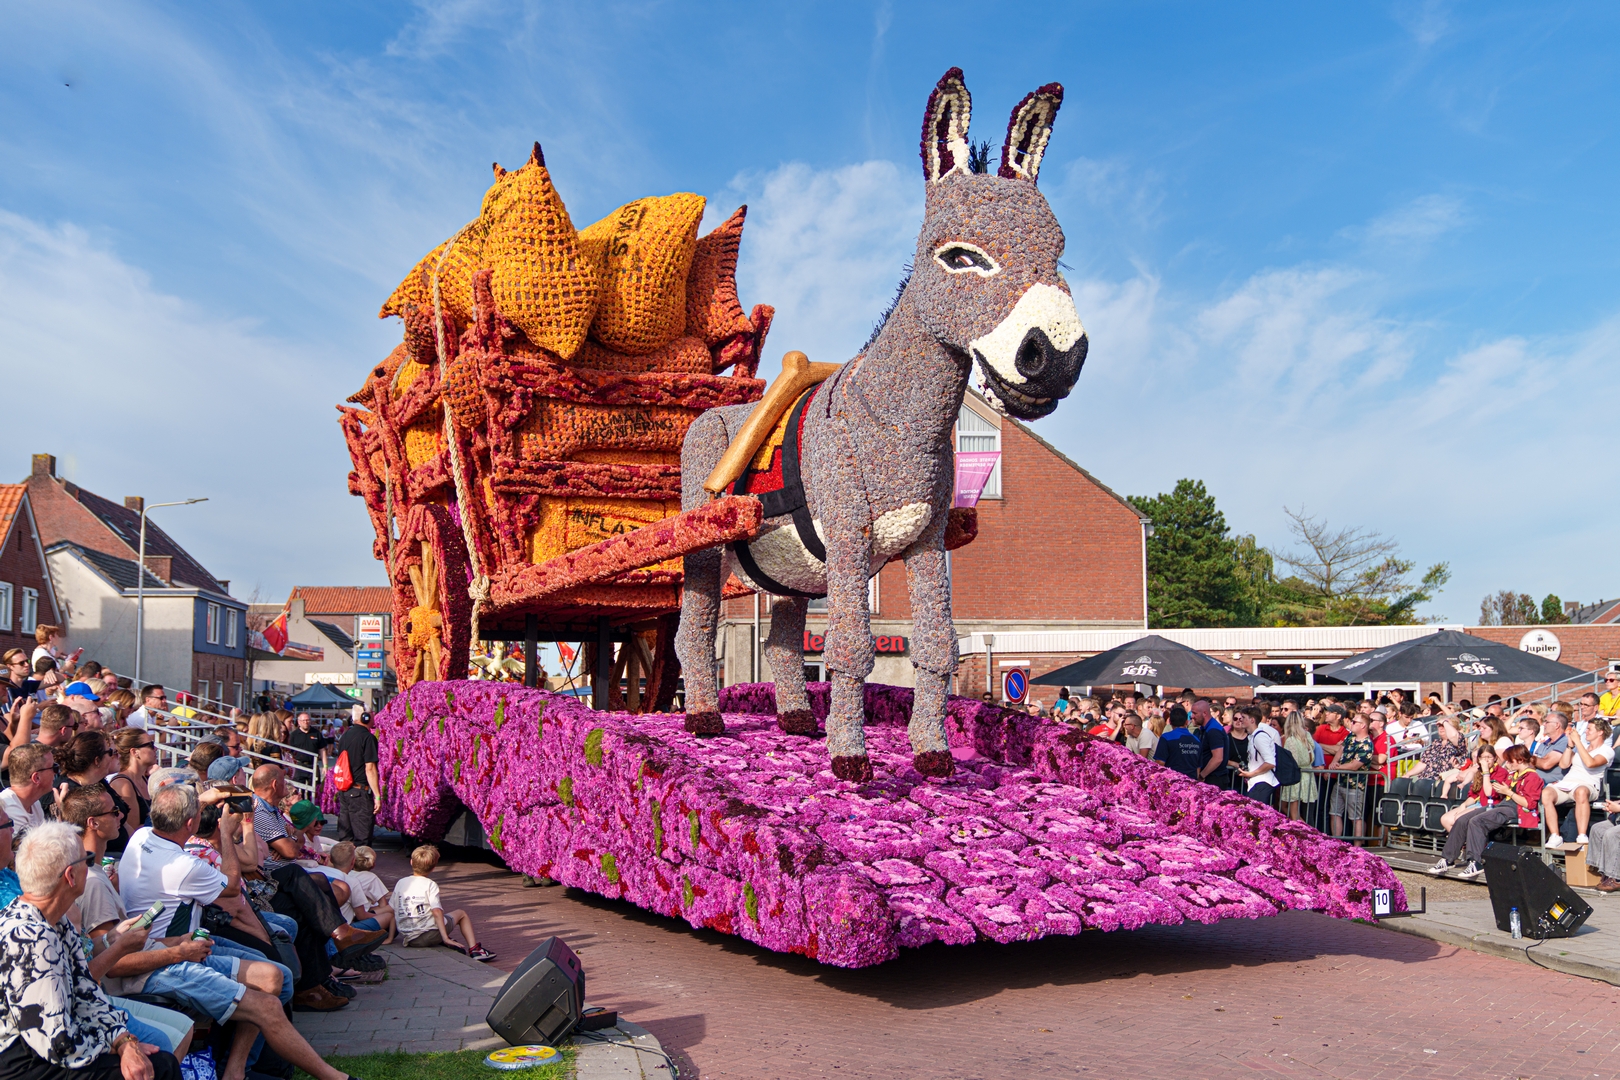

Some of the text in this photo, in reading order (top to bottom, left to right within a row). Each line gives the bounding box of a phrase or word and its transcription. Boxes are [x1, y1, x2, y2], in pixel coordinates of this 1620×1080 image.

[361, 617, 380, 626] AVIA
[1525, 643, 1557, 654] Jupiler
[1120, 664, 1157, 676] Leffe
[1451, 662, 1495, 676] Leffe
[1376, 892, 1388, 906] 10
